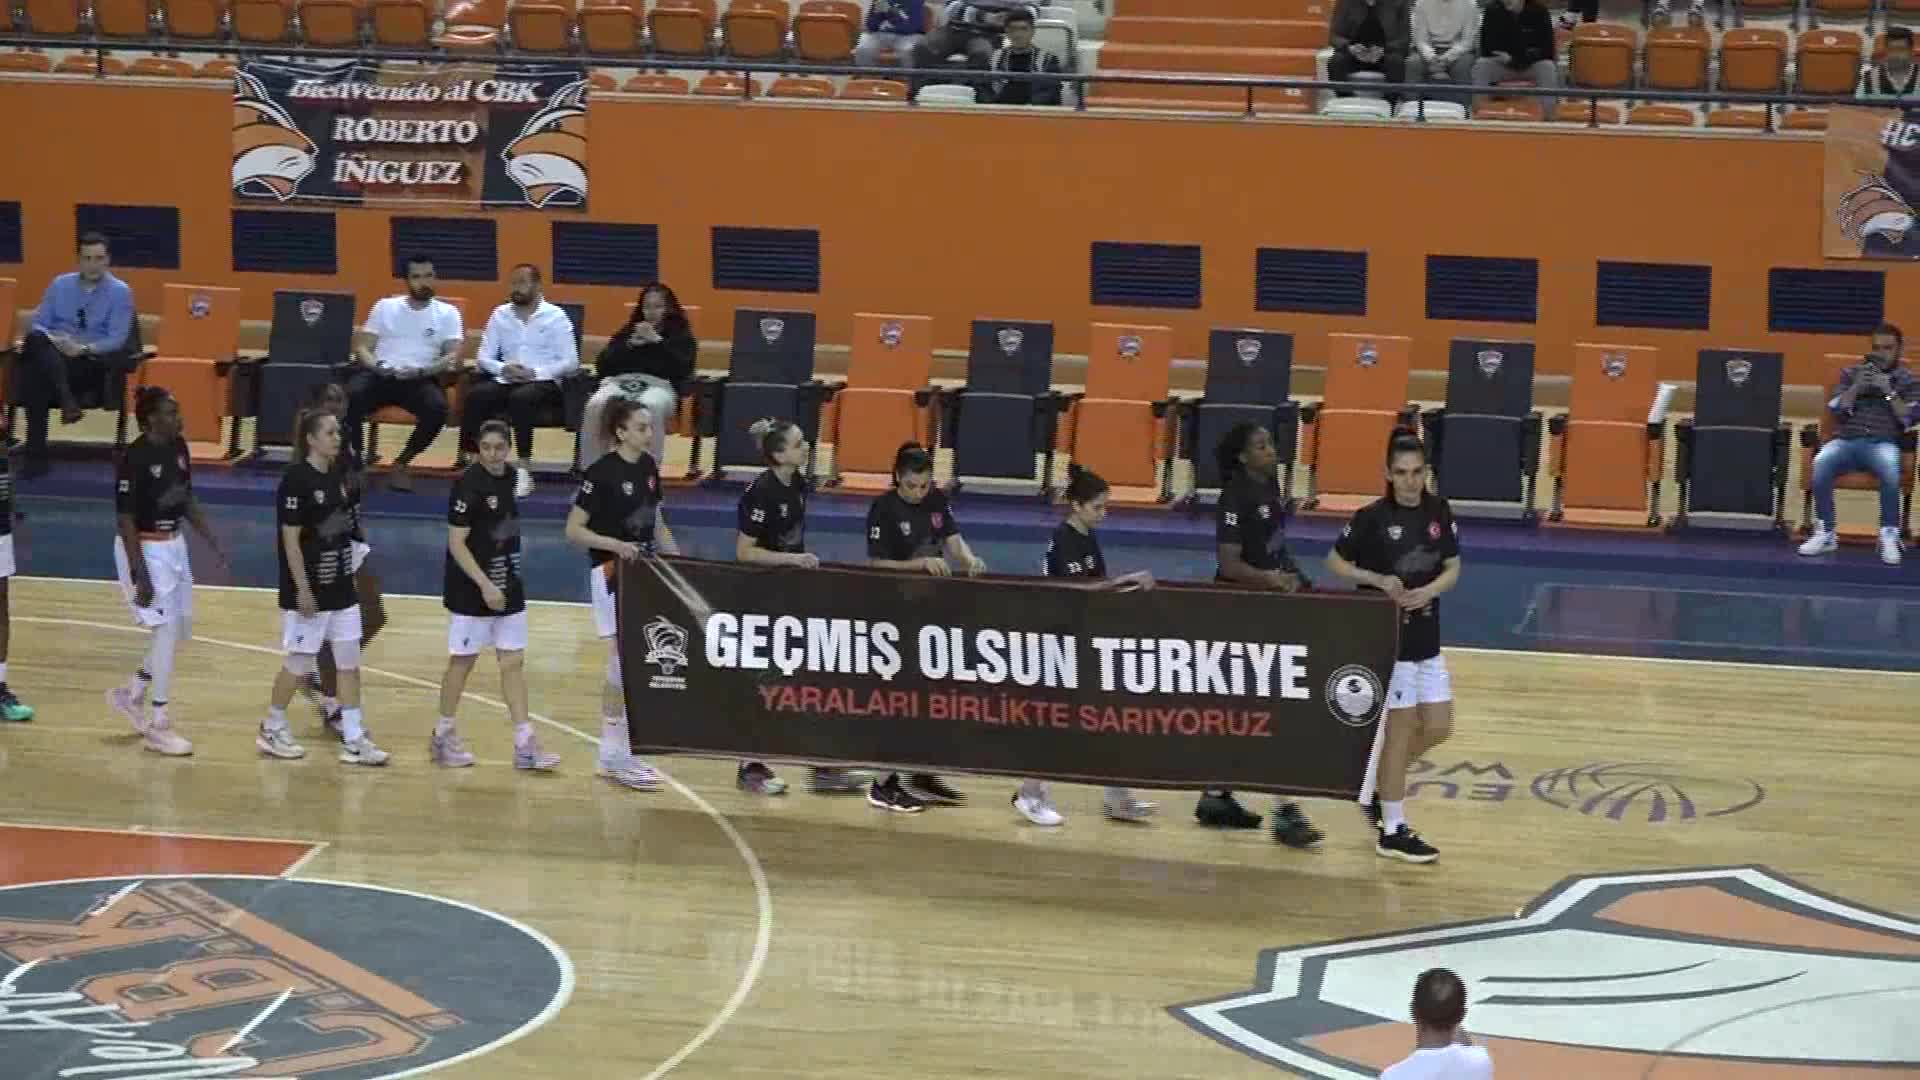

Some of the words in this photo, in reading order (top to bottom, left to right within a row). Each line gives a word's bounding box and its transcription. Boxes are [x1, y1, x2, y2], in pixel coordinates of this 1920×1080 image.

[288, 78, 441, 103] Bienvenido
[445, 81, 473, 103] al
[474, 80, 544, 104] CBK
[333, 116, 480, 144] ROBERTO
[918, 624, 1080, 690] OLSUN
[759, 684, 919, 719] YARALARI
[929, 687, 1070, 729] BİRLİKTE
[1080, 705, 1273, 738] SARIYORUZ
